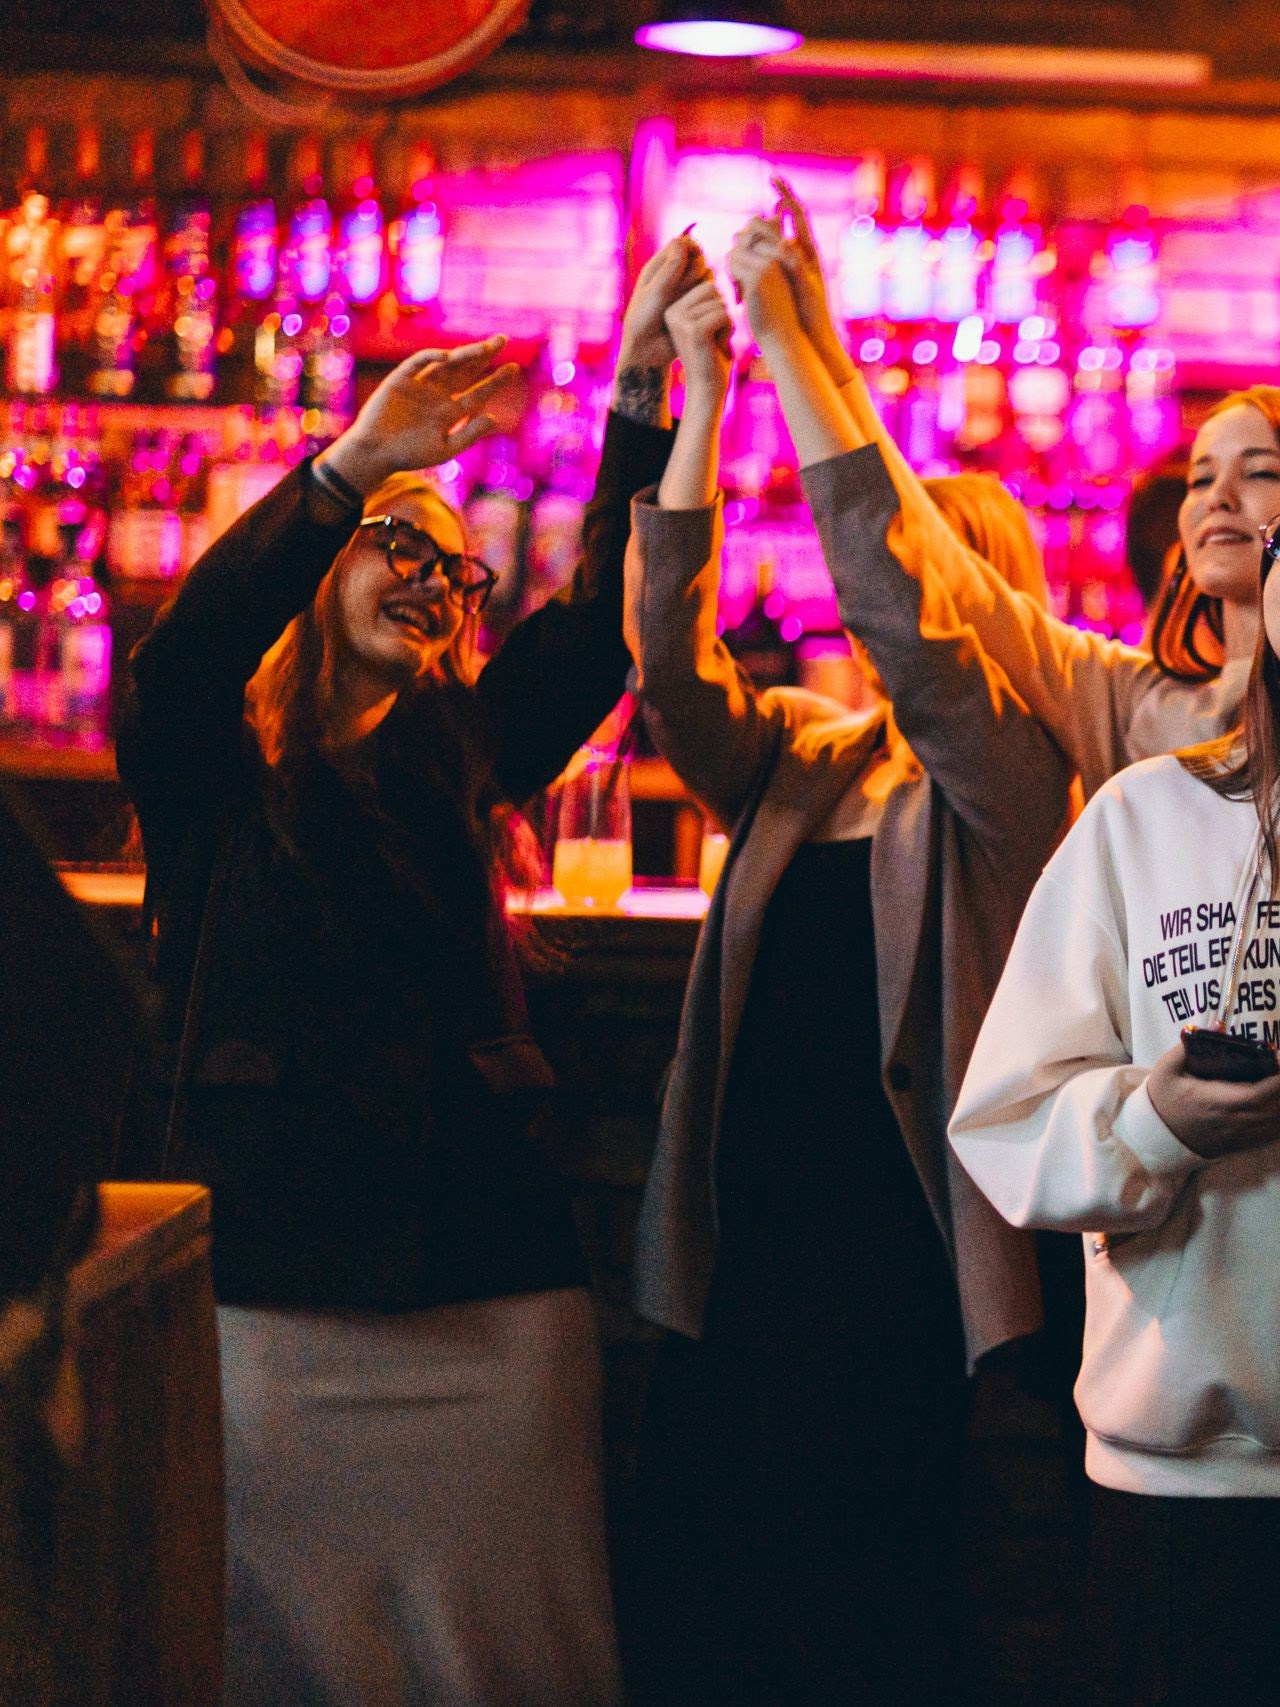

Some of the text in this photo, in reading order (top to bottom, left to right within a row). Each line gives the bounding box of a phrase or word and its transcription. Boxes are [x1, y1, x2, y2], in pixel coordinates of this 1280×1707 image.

[1160, 906, 1192, 941] WIR
[1142, 952, 1169, 988] DIE
[1168, 942, 1206, 978] TEIL
[1161, 987, 1195, 1023] TEIL
